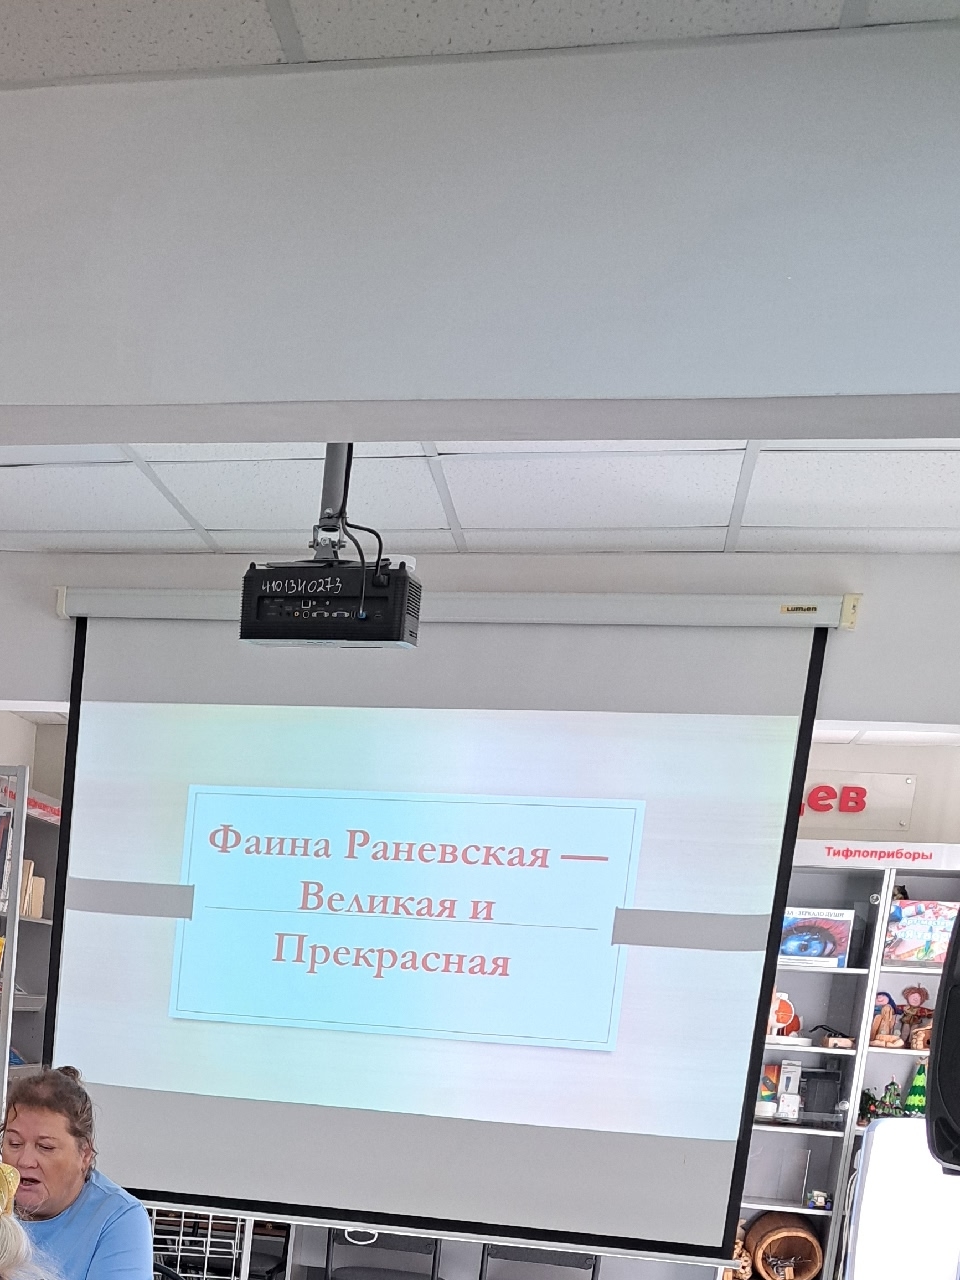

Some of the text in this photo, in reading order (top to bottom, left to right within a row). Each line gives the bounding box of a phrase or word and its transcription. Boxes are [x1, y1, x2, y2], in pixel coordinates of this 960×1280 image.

[799, 785, 867, 816] ев
[208, 823, 332, 859] Фаина
[343, 829, 551, 868] Раневская
[825, 846, 933, 861] Тифлоприборы
[297, 880, 496, 921] Великая и
[271, 932, 512, 978] Прекрасная
